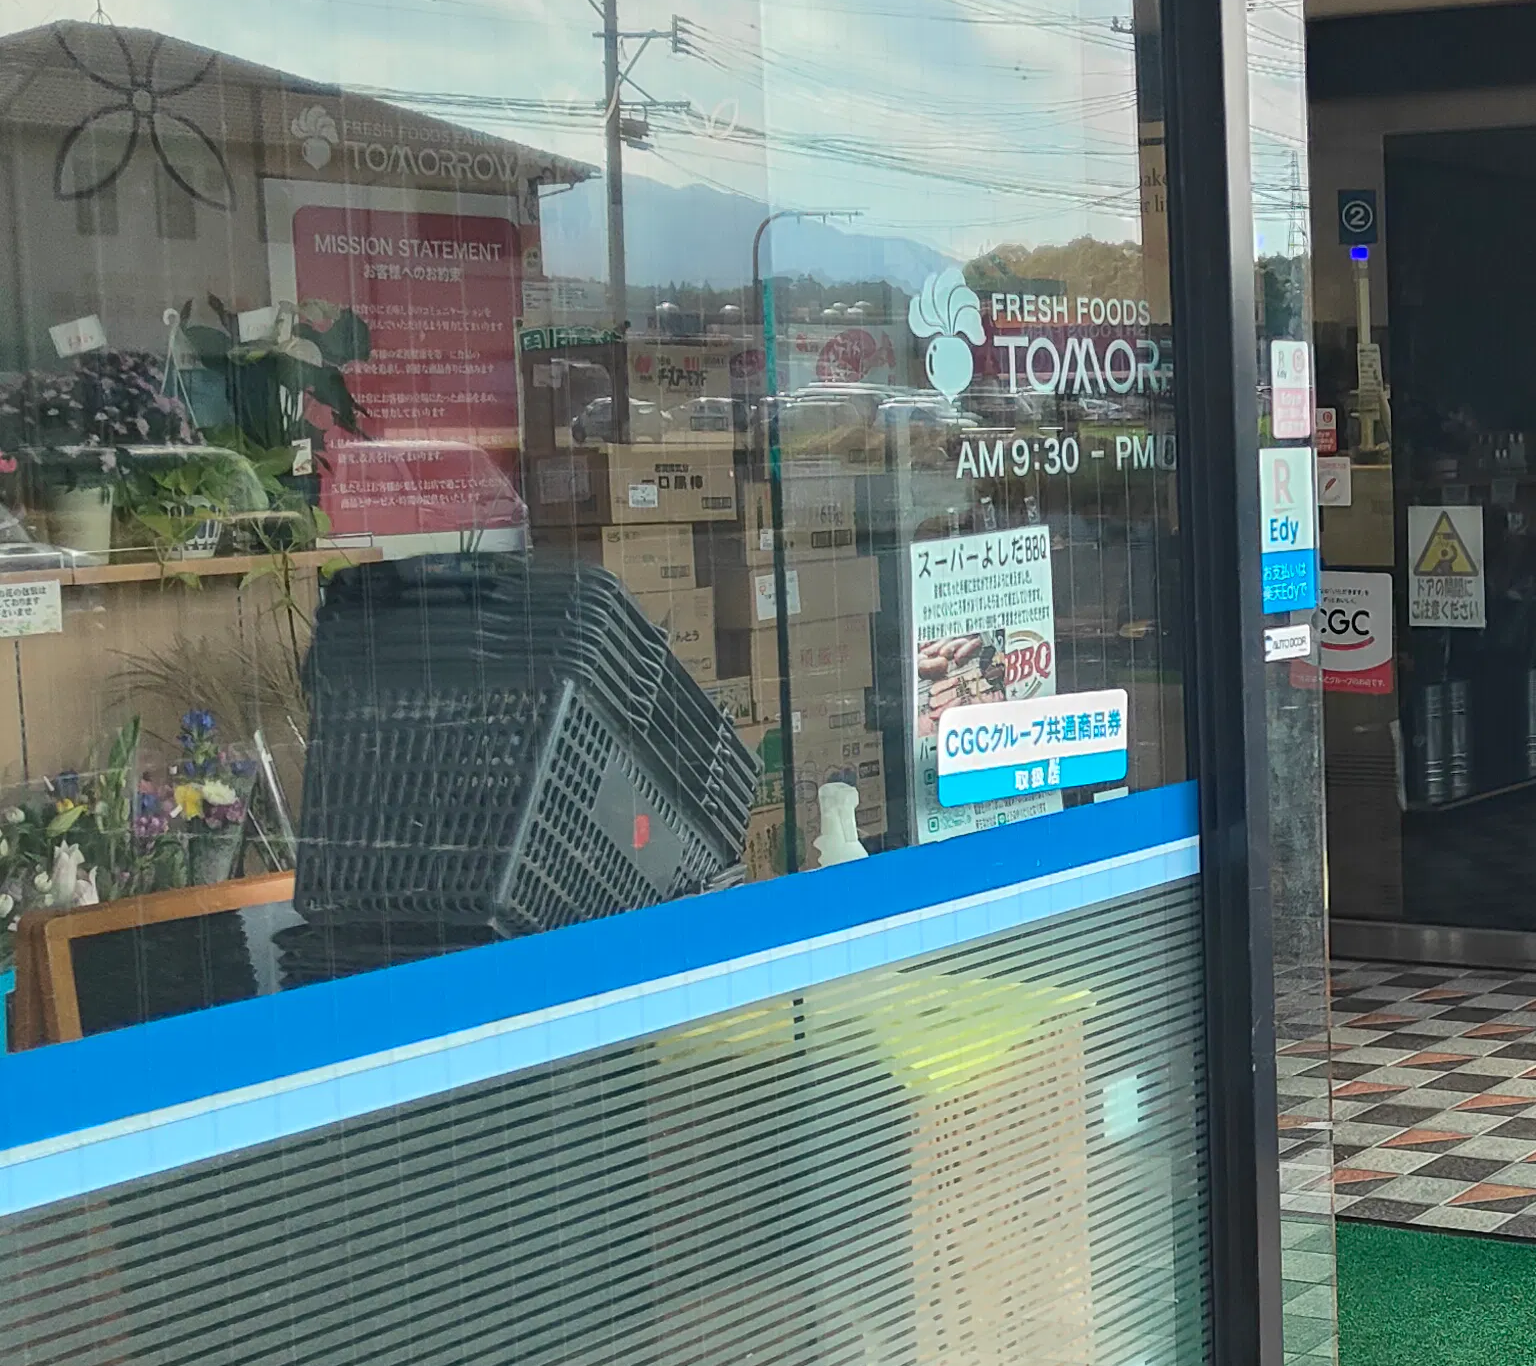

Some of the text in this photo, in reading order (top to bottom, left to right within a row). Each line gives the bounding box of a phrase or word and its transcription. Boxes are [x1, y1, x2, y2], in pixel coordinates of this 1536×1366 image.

[344, 139, 522, 183] TOMORROW
[314, 234, 502, 261] MISSION STATEMENT
[363, 263, 463, 282] お客様へのお約束
[991, 293, 1151, 326] FRESH FOODS
[1269, 516, 1300, 545] Edy
[917, 533, 1047, 578] スーパーよしだBBQ
[1262, 562, 1307, 580] お支払いは
[1262, 582, 1308, 602] 楽天Edyで
[1416, 577, 1474, 598] ドアの開閉に
[1411, 599, 1480, 620] ご注意ください
[1004, 641, 1051, 685] BBQ
[945, 708, 1122, 758] CGCグループ共通商品券
[1014, 757, 1061, 790] 取扱店
